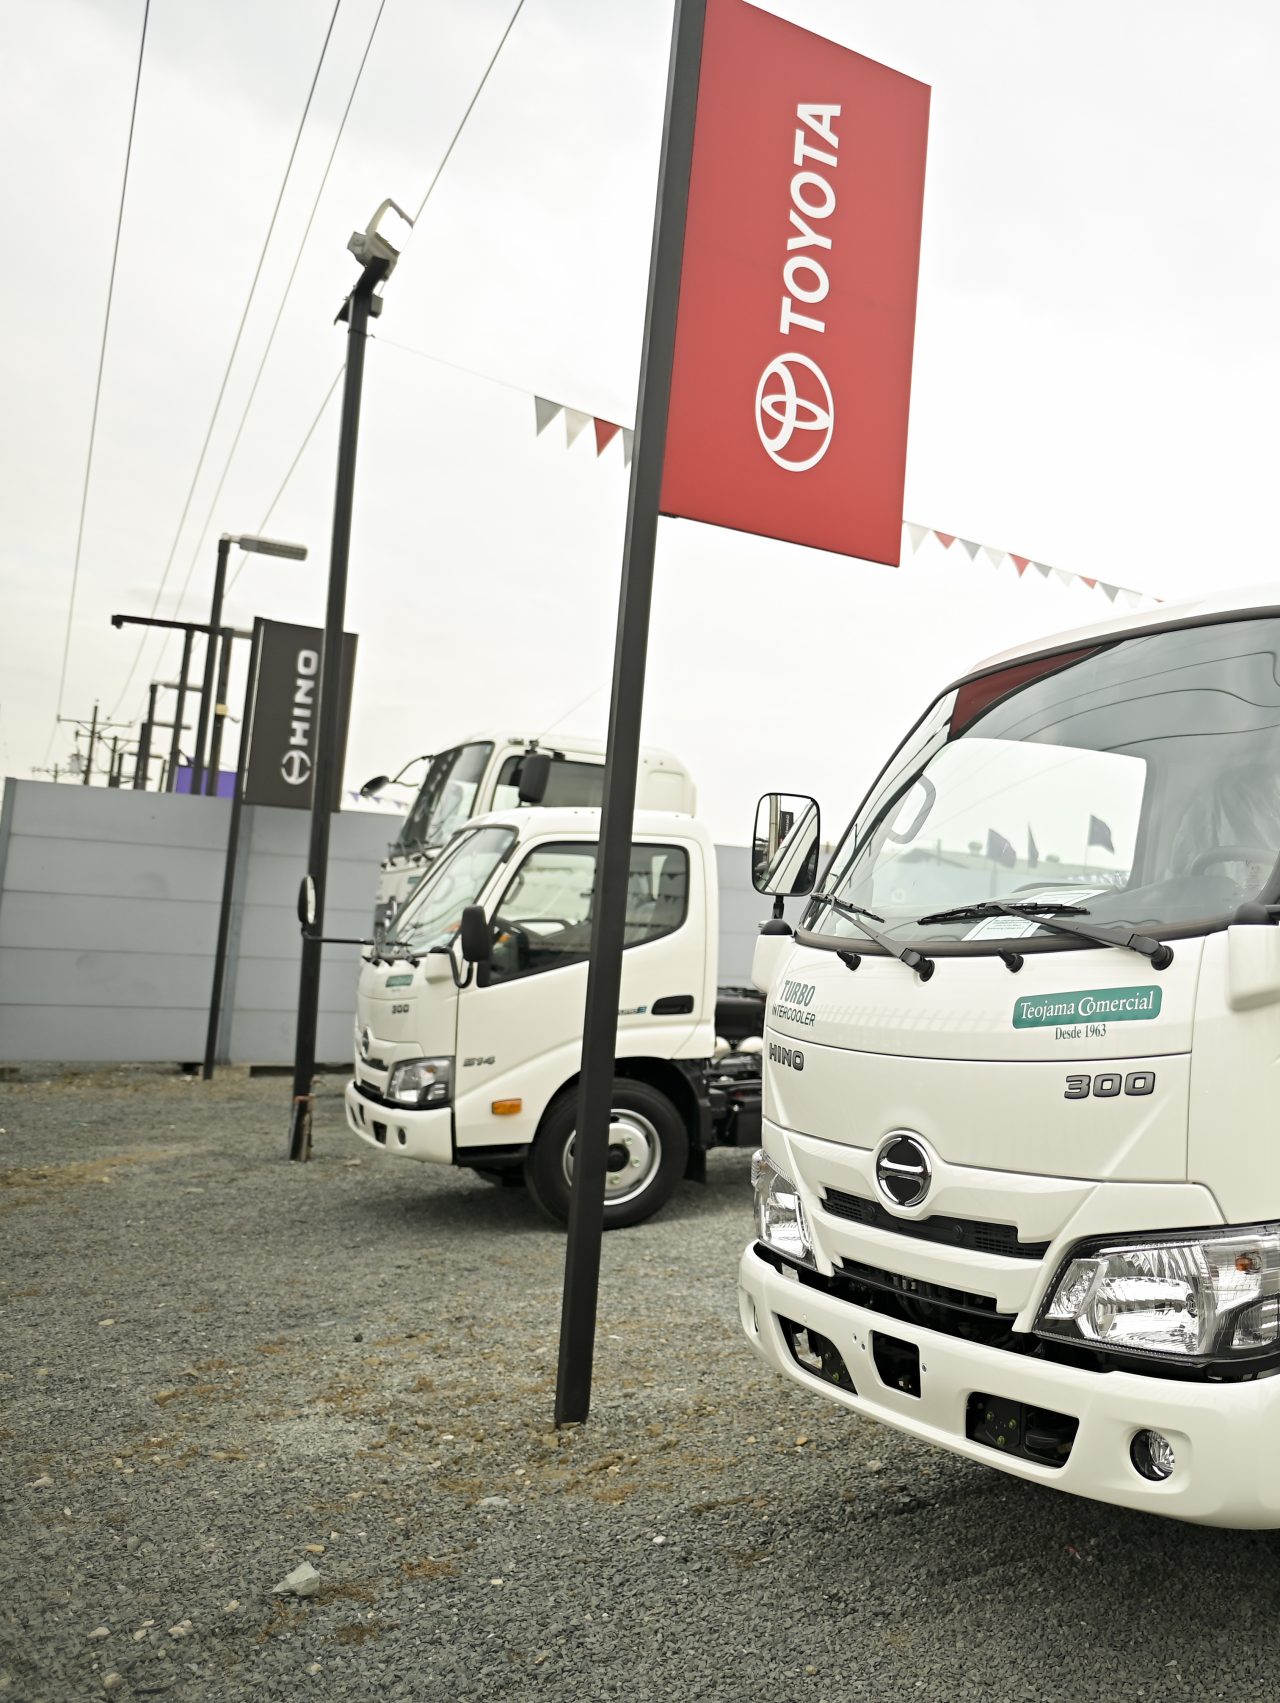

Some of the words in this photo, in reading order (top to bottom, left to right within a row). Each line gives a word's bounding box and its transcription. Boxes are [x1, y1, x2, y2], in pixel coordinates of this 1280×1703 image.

[779, 103, 842, 335] TOYOTA
[289, 649, 319, 747] HINO
[780, 980, 816, 1007] TURBO
[1020, 1000, 1075, 1022] Teojama
[1078, 991, 1154, 1017] Comercial
[772, 1004, 816, 1027] INTERCOOLER
[1055, 1025, 1082, 1041] Desde
[1085, 1024, 1107, 1038] 1963
[769, 1042, 805, 1072] HINO
[1063, 1071, 1156, 1100] 300
